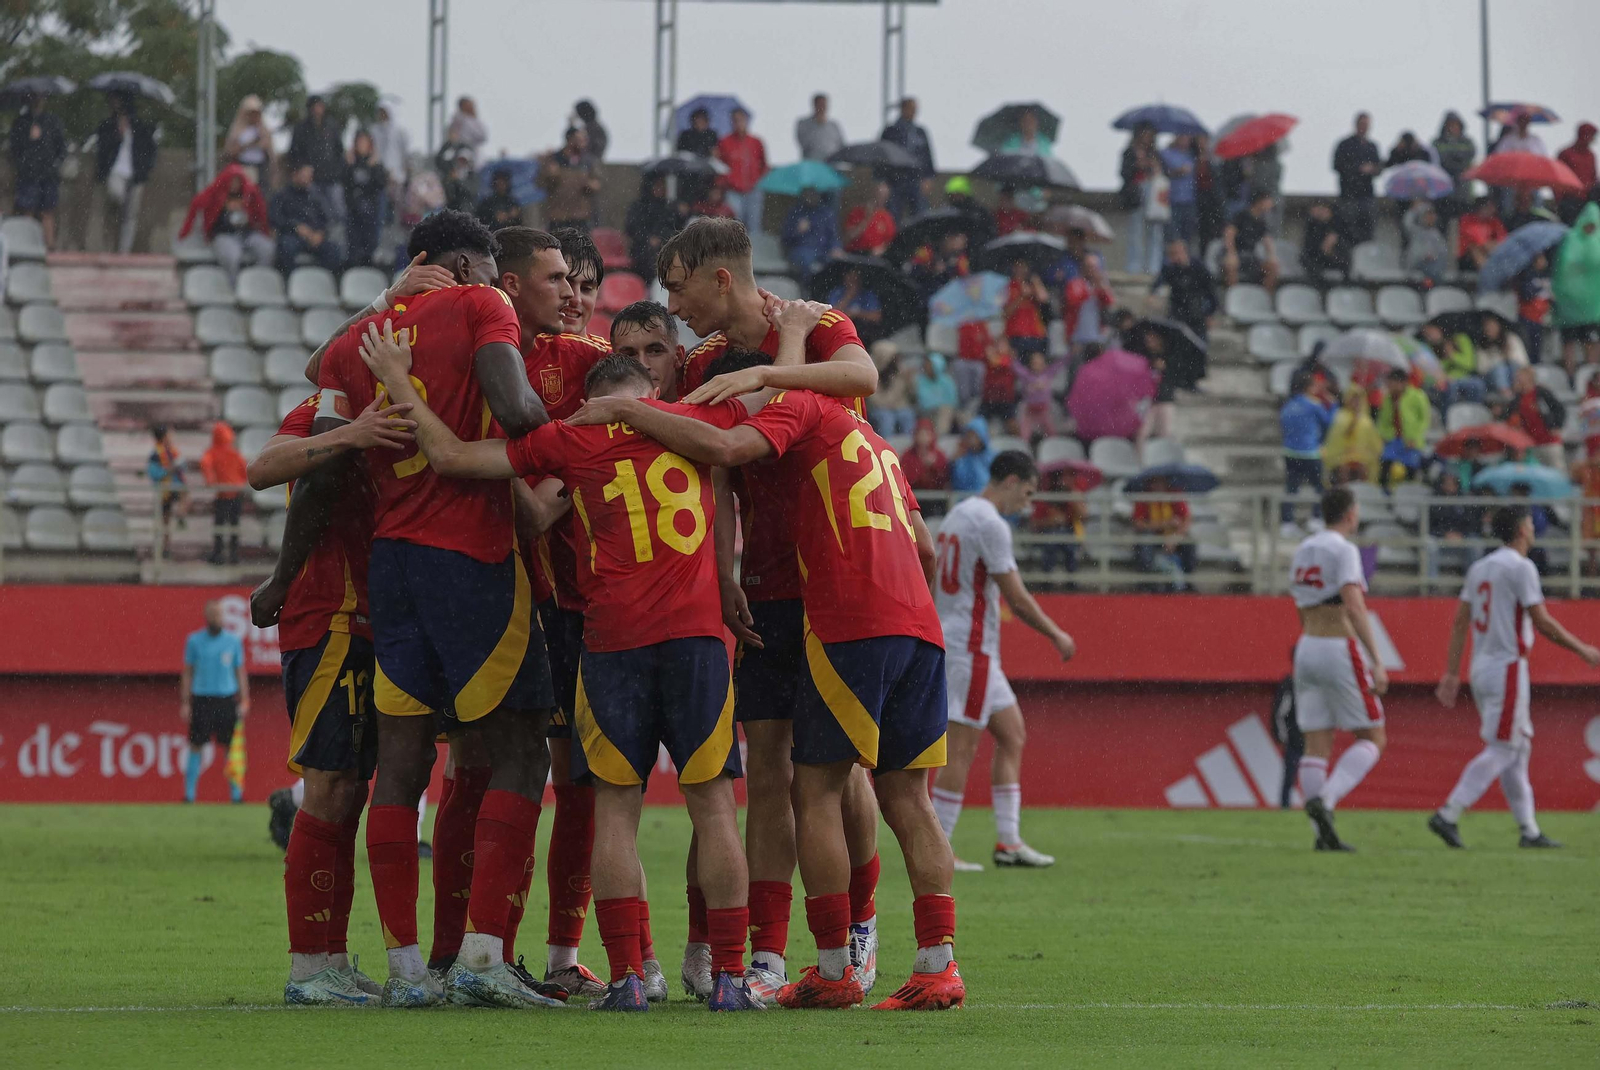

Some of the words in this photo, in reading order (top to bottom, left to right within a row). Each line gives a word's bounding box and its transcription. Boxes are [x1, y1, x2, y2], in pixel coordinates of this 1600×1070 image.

[602, 451, 707, 563] 18
[841, 429, 917, 542] 20
[1474, 580, 1492, 634] 3
[17, 722, 84, 779] de
[88, 720, 217, 779] Toro
